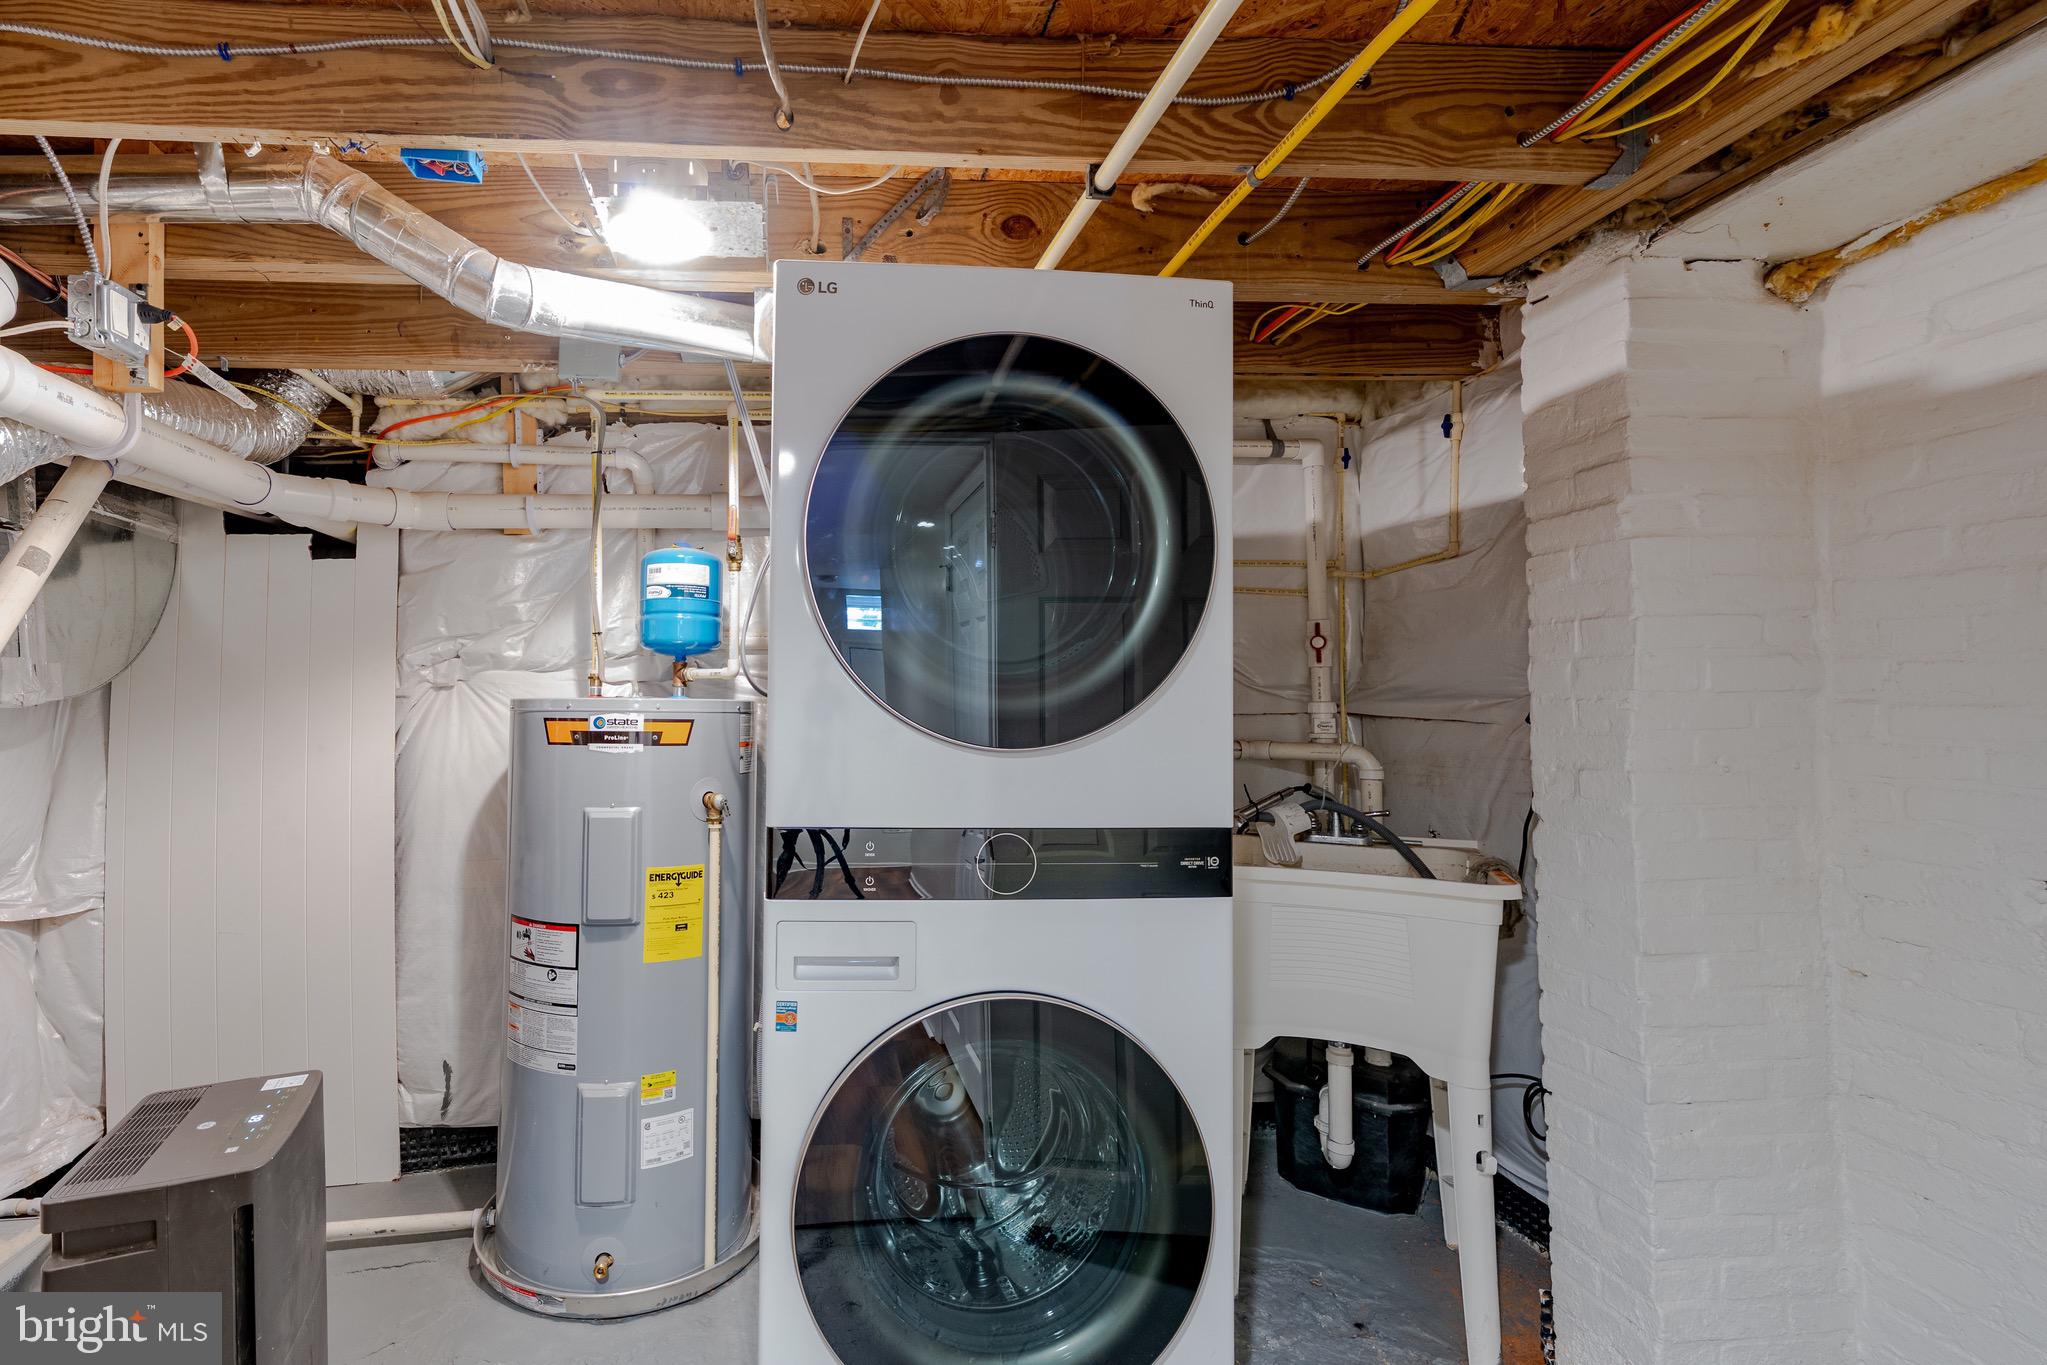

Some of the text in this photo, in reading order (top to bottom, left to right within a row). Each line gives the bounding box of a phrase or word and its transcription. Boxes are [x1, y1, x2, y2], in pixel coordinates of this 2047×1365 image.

[818, 281, 838, 294] LG
[1189, 299, 1215, 309] ThinQ
[606, 718, 639, 726] state
[658, 891, 674, 899] 423
